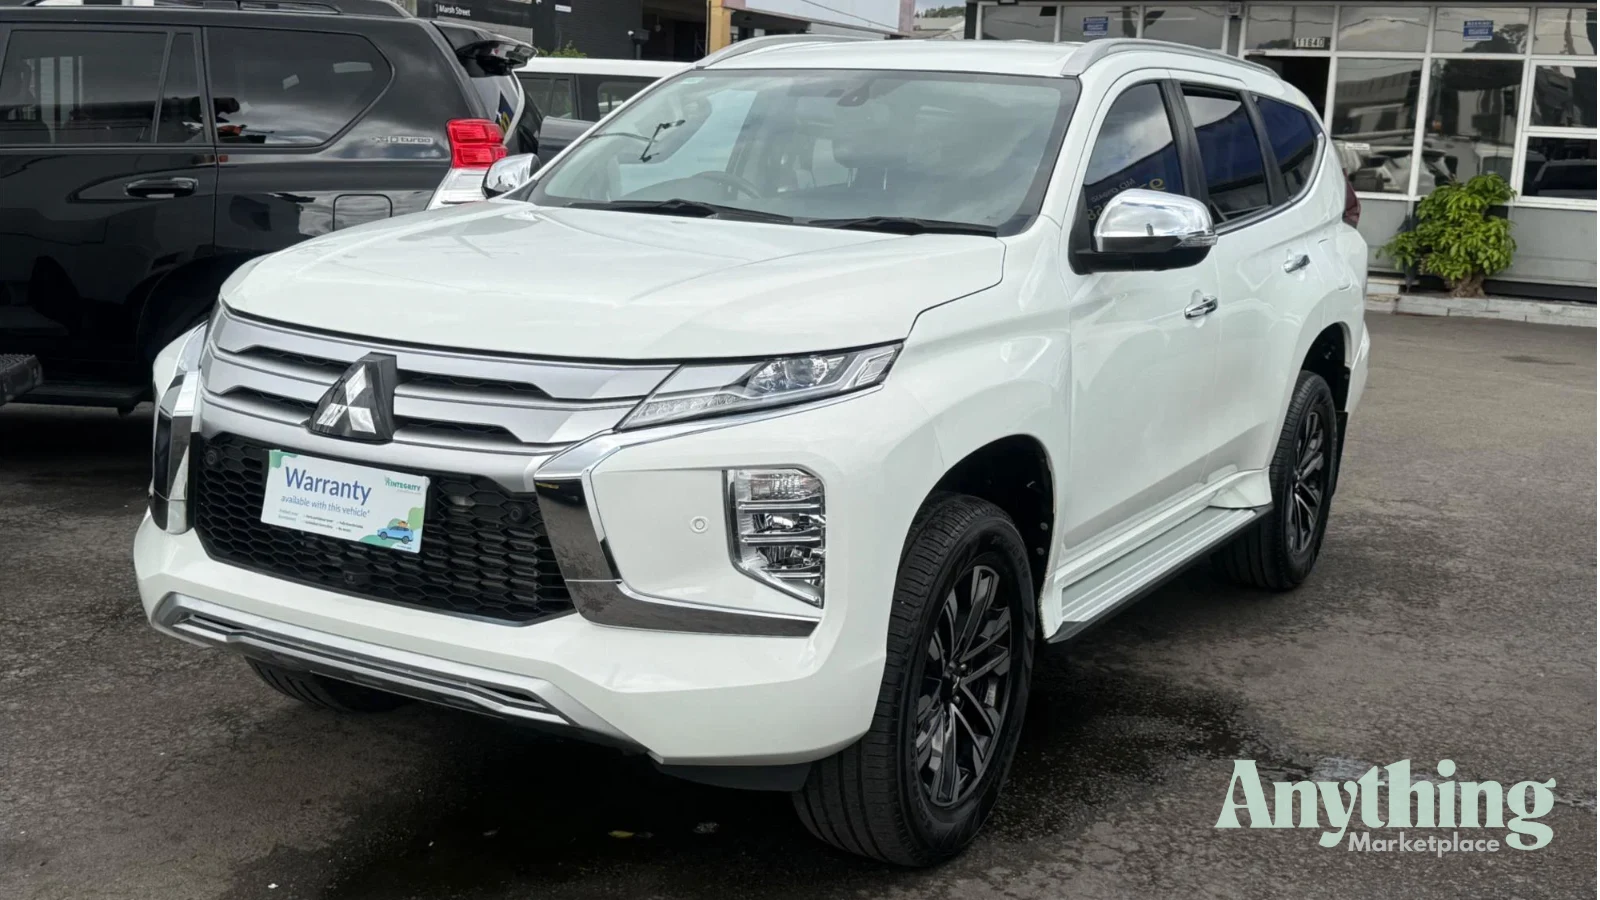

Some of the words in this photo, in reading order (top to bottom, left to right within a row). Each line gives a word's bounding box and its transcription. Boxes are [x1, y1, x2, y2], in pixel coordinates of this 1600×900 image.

[439, 4, 455, 14] Marsh
[455, 6, 471, 16] Street
[285, 466, 372, 506] Warranty
[390, 480, 422, 491] INTEGRITY
[280, 495, 310, 508] available
[311, 501, 327, 511] with
[328, 503, 341, 513] this
